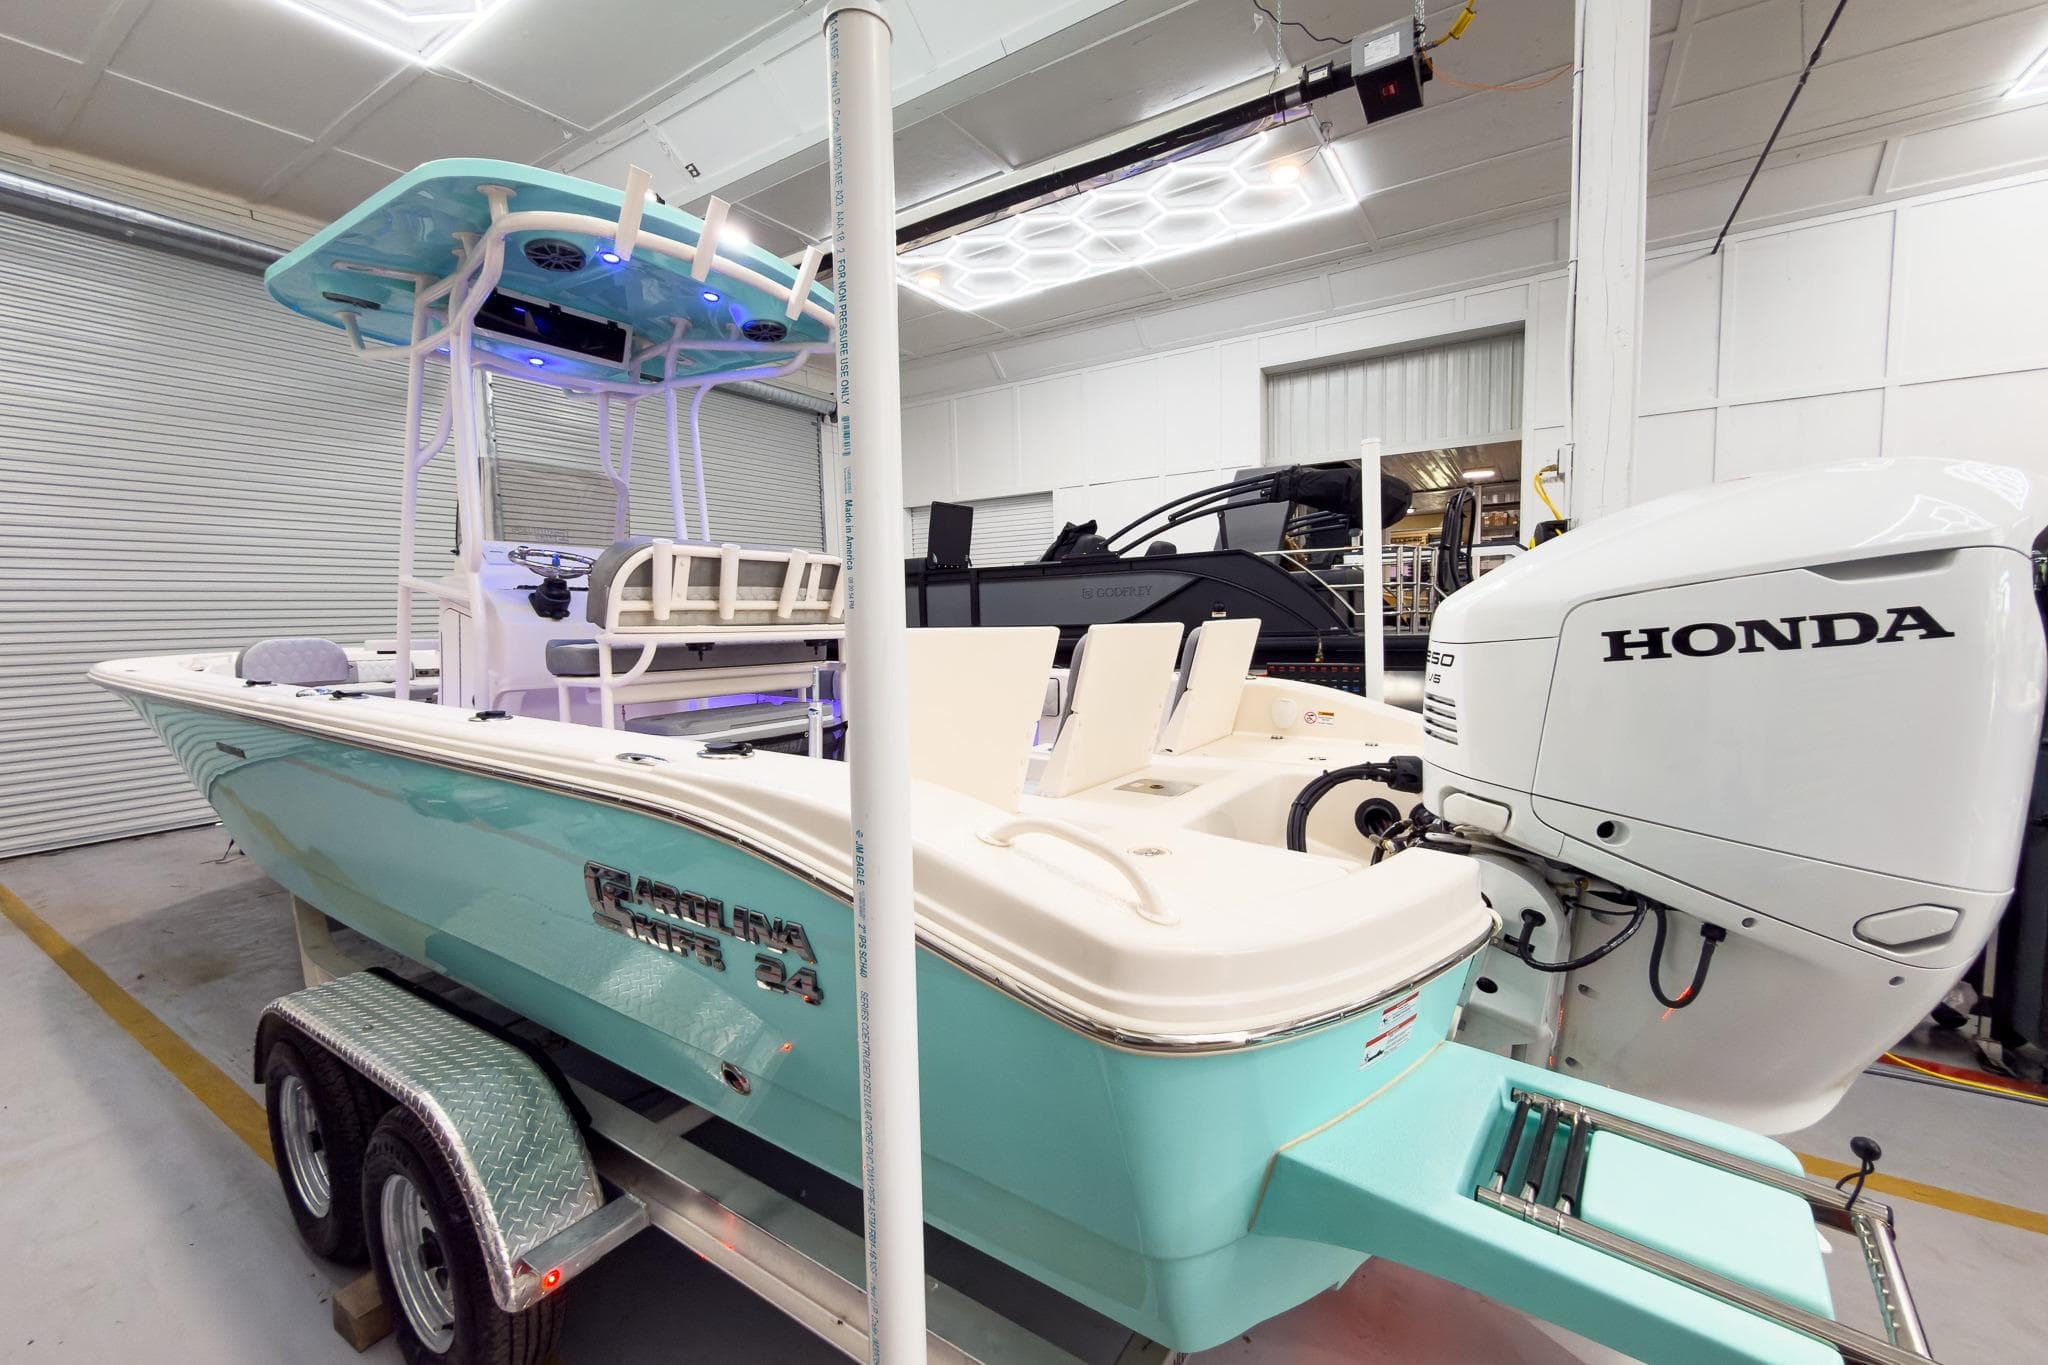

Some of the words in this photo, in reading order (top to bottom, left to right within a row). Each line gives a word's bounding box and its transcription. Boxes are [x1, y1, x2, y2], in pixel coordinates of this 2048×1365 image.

[837, 258, 847, 280] FOR
[838, 281, 847, 303] NON
[839, 303, 848, 356] PRESSURE
[840, 357, 849, 378] USE
[841, 379, 850, 405] ONLY
[844, 499, 854, 523] Made
[845, 525, 854, 534] in
[846, 535, 855, 571] America
[1096, 585, 1153, 598] GODFREY
[1600, 605, 1956, 662] HONDA
[856, 841, 864, 854] JM
[856, 855, 865, 886] EAGLE
[584, 860, 818, 964] CAROLINA
[859, 935, 867, 949] IPS
[859, 950, 868, 978] SCH40
[755, 952, 824, 1006] 24
